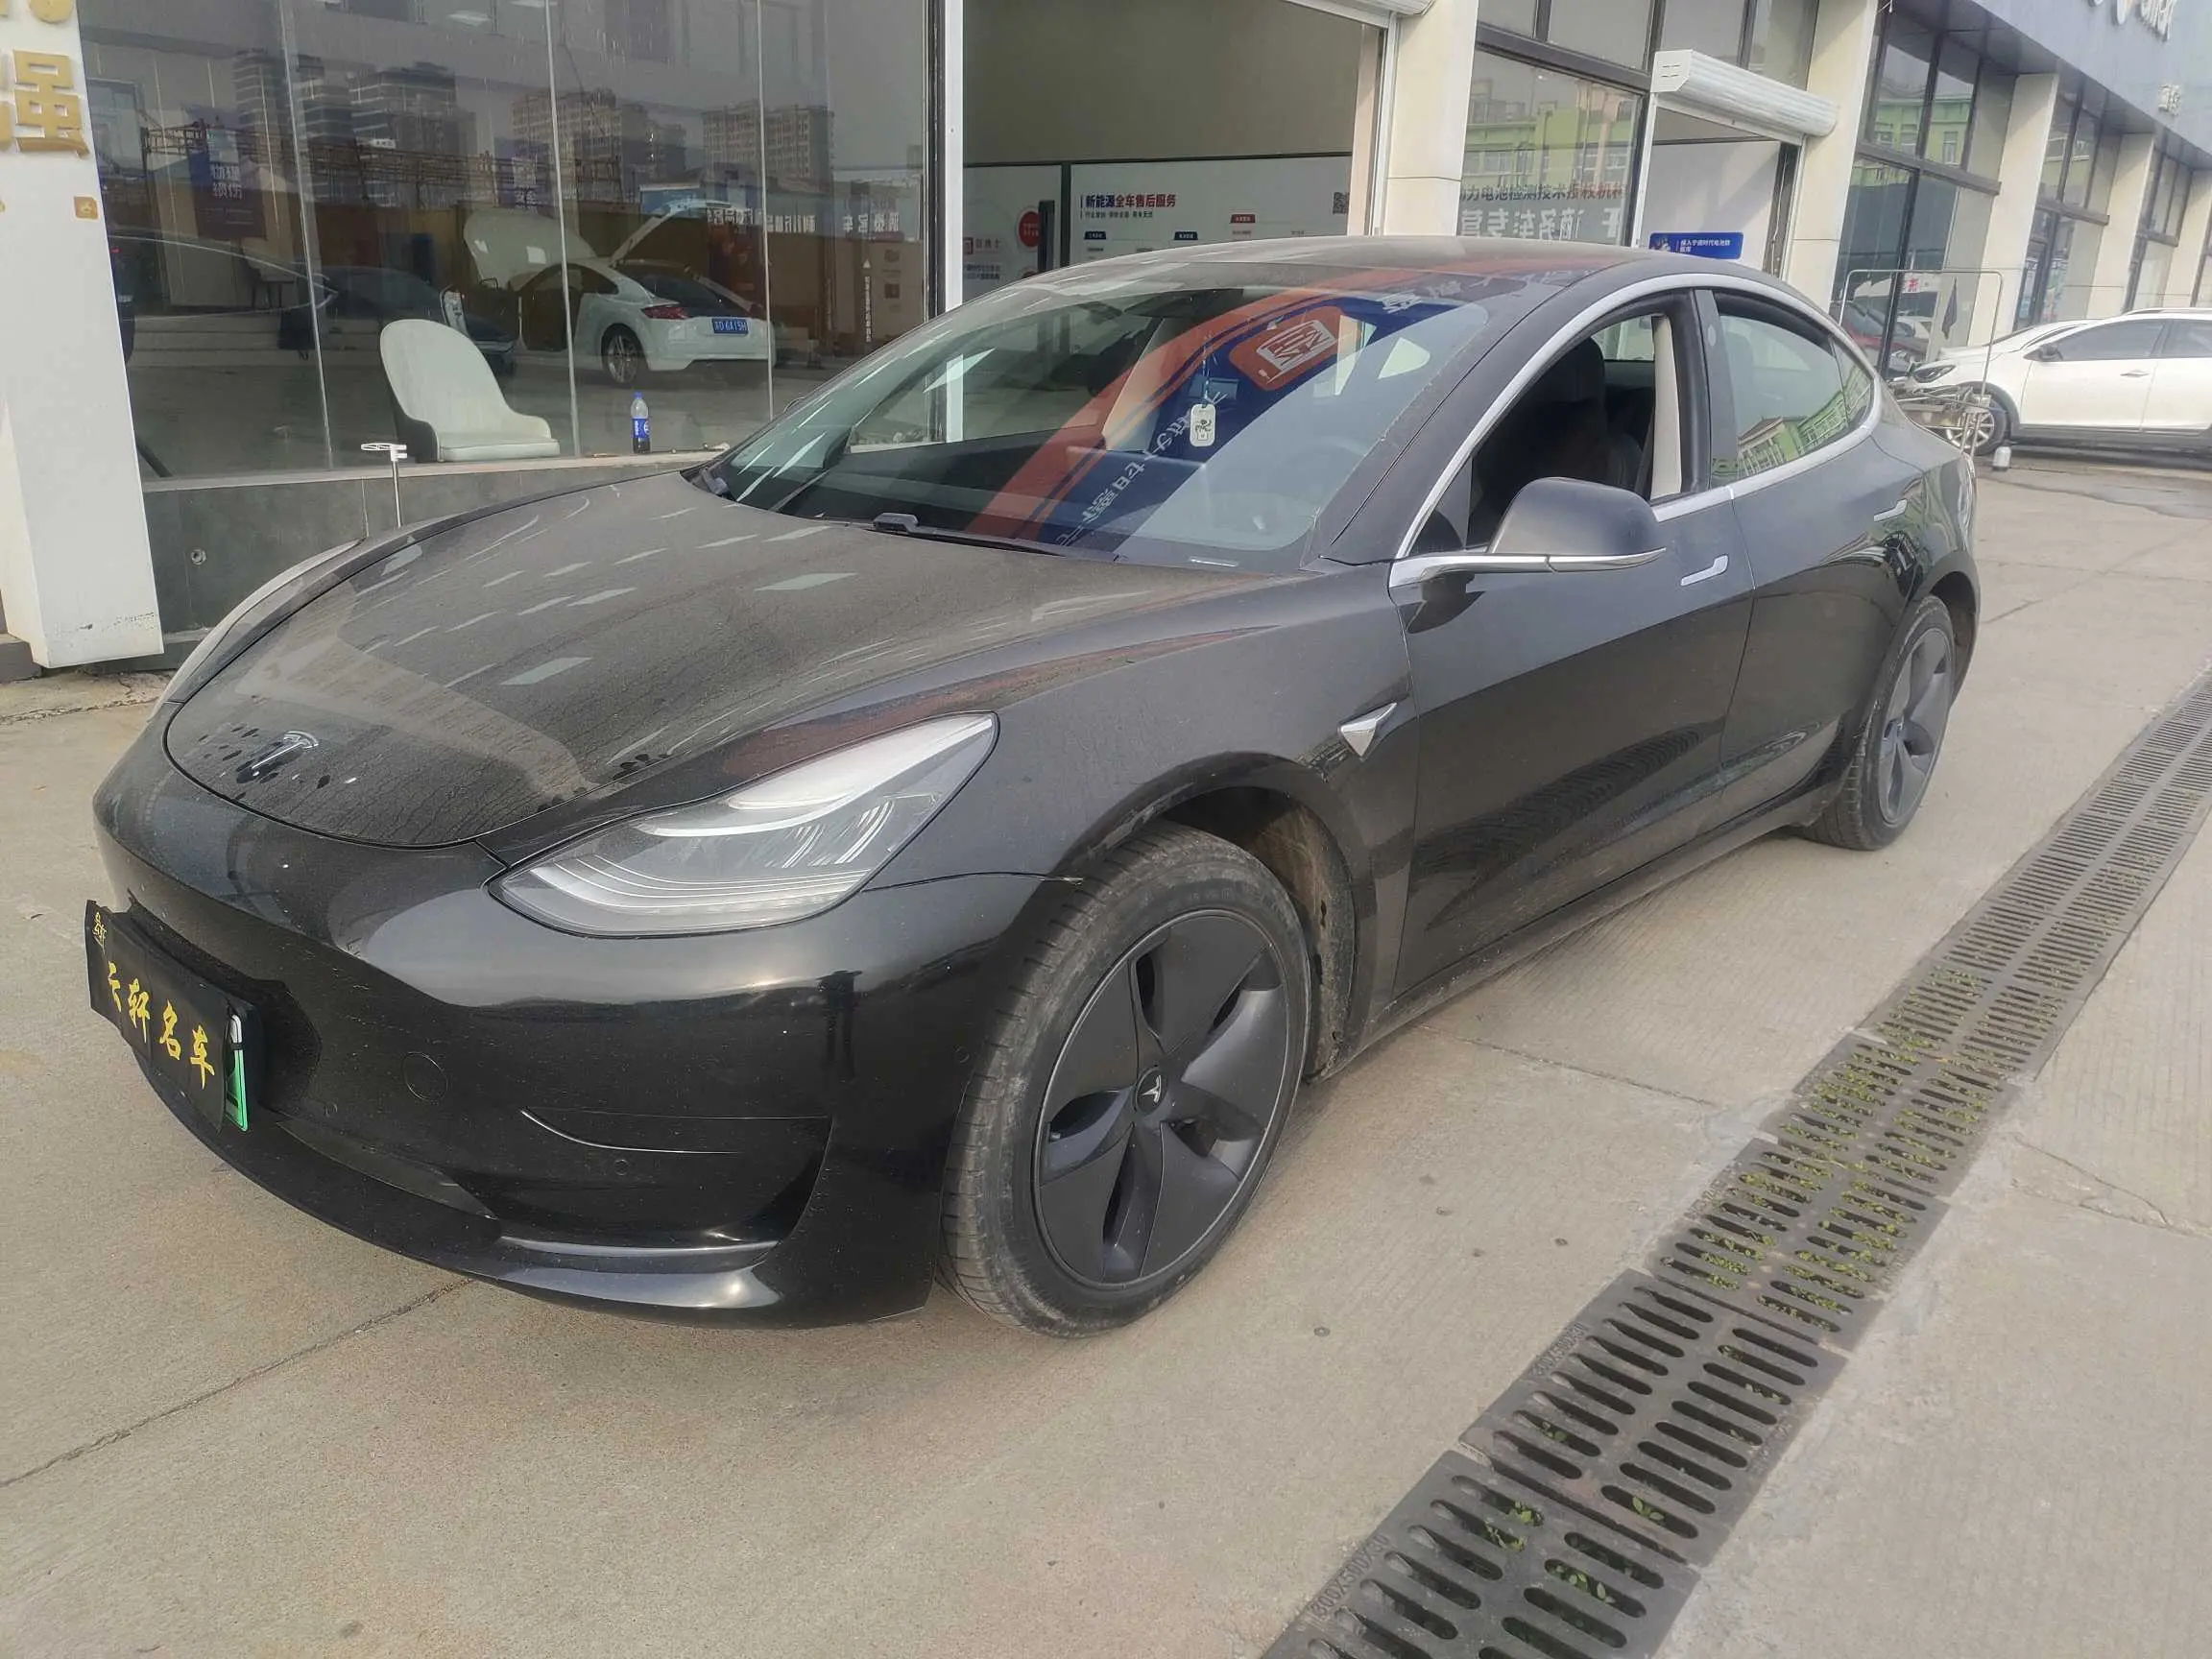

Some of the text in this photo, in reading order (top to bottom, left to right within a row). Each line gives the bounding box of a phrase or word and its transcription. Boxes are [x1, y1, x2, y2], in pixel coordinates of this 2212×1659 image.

[1086, 194, 1176, 208] 新能源全车售后服务
[1308, 1533, 1391, 1621] 300X500X30
